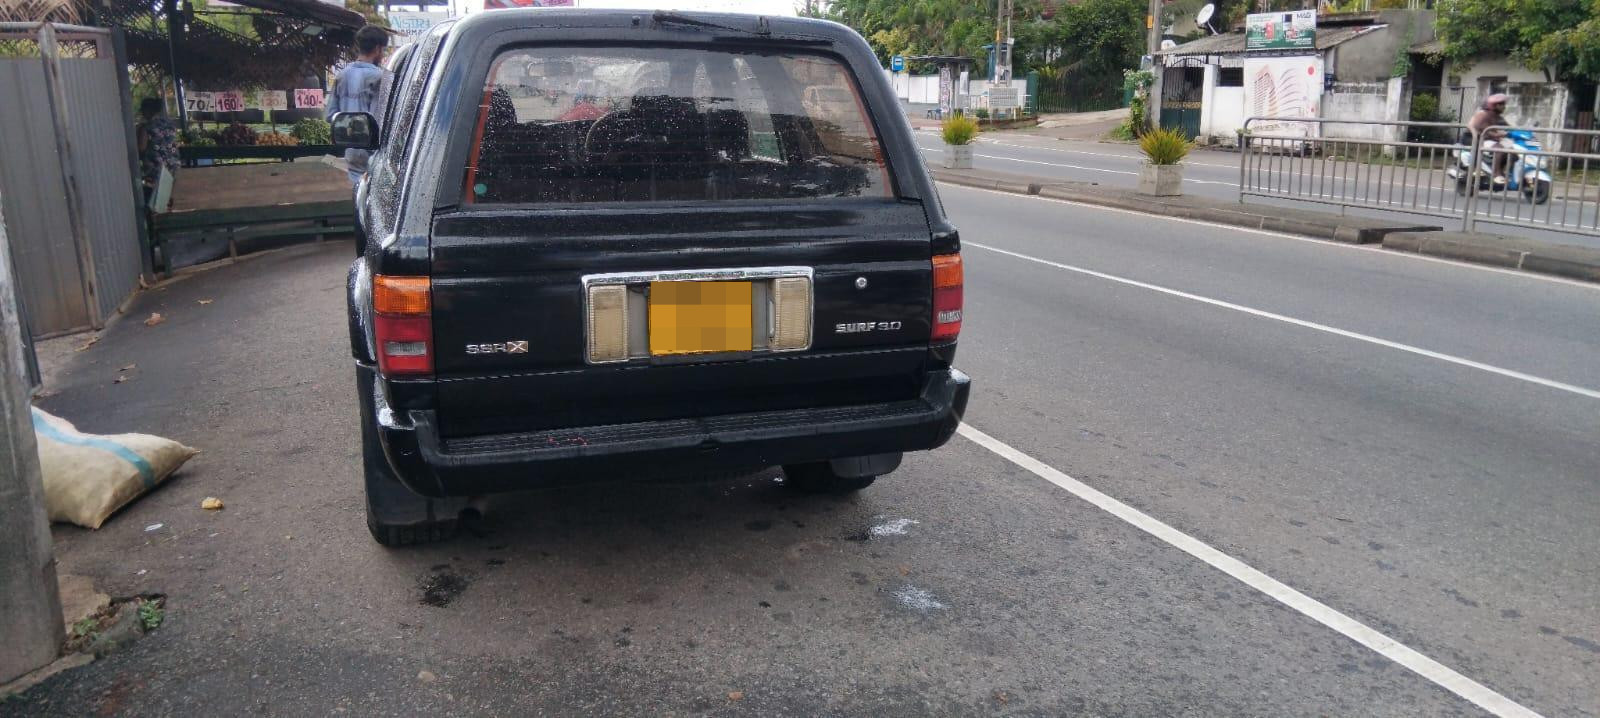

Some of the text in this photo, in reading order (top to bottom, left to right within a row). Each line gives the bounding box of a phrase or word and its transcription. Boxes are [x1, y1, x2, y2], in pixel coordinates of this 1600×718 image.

[187, 99, 214, 111] 70/-
[217, 98, 243, 111] 160/-
[297, 94, 323, 107] 140/-
[835, 322, 876, 333] SURF
